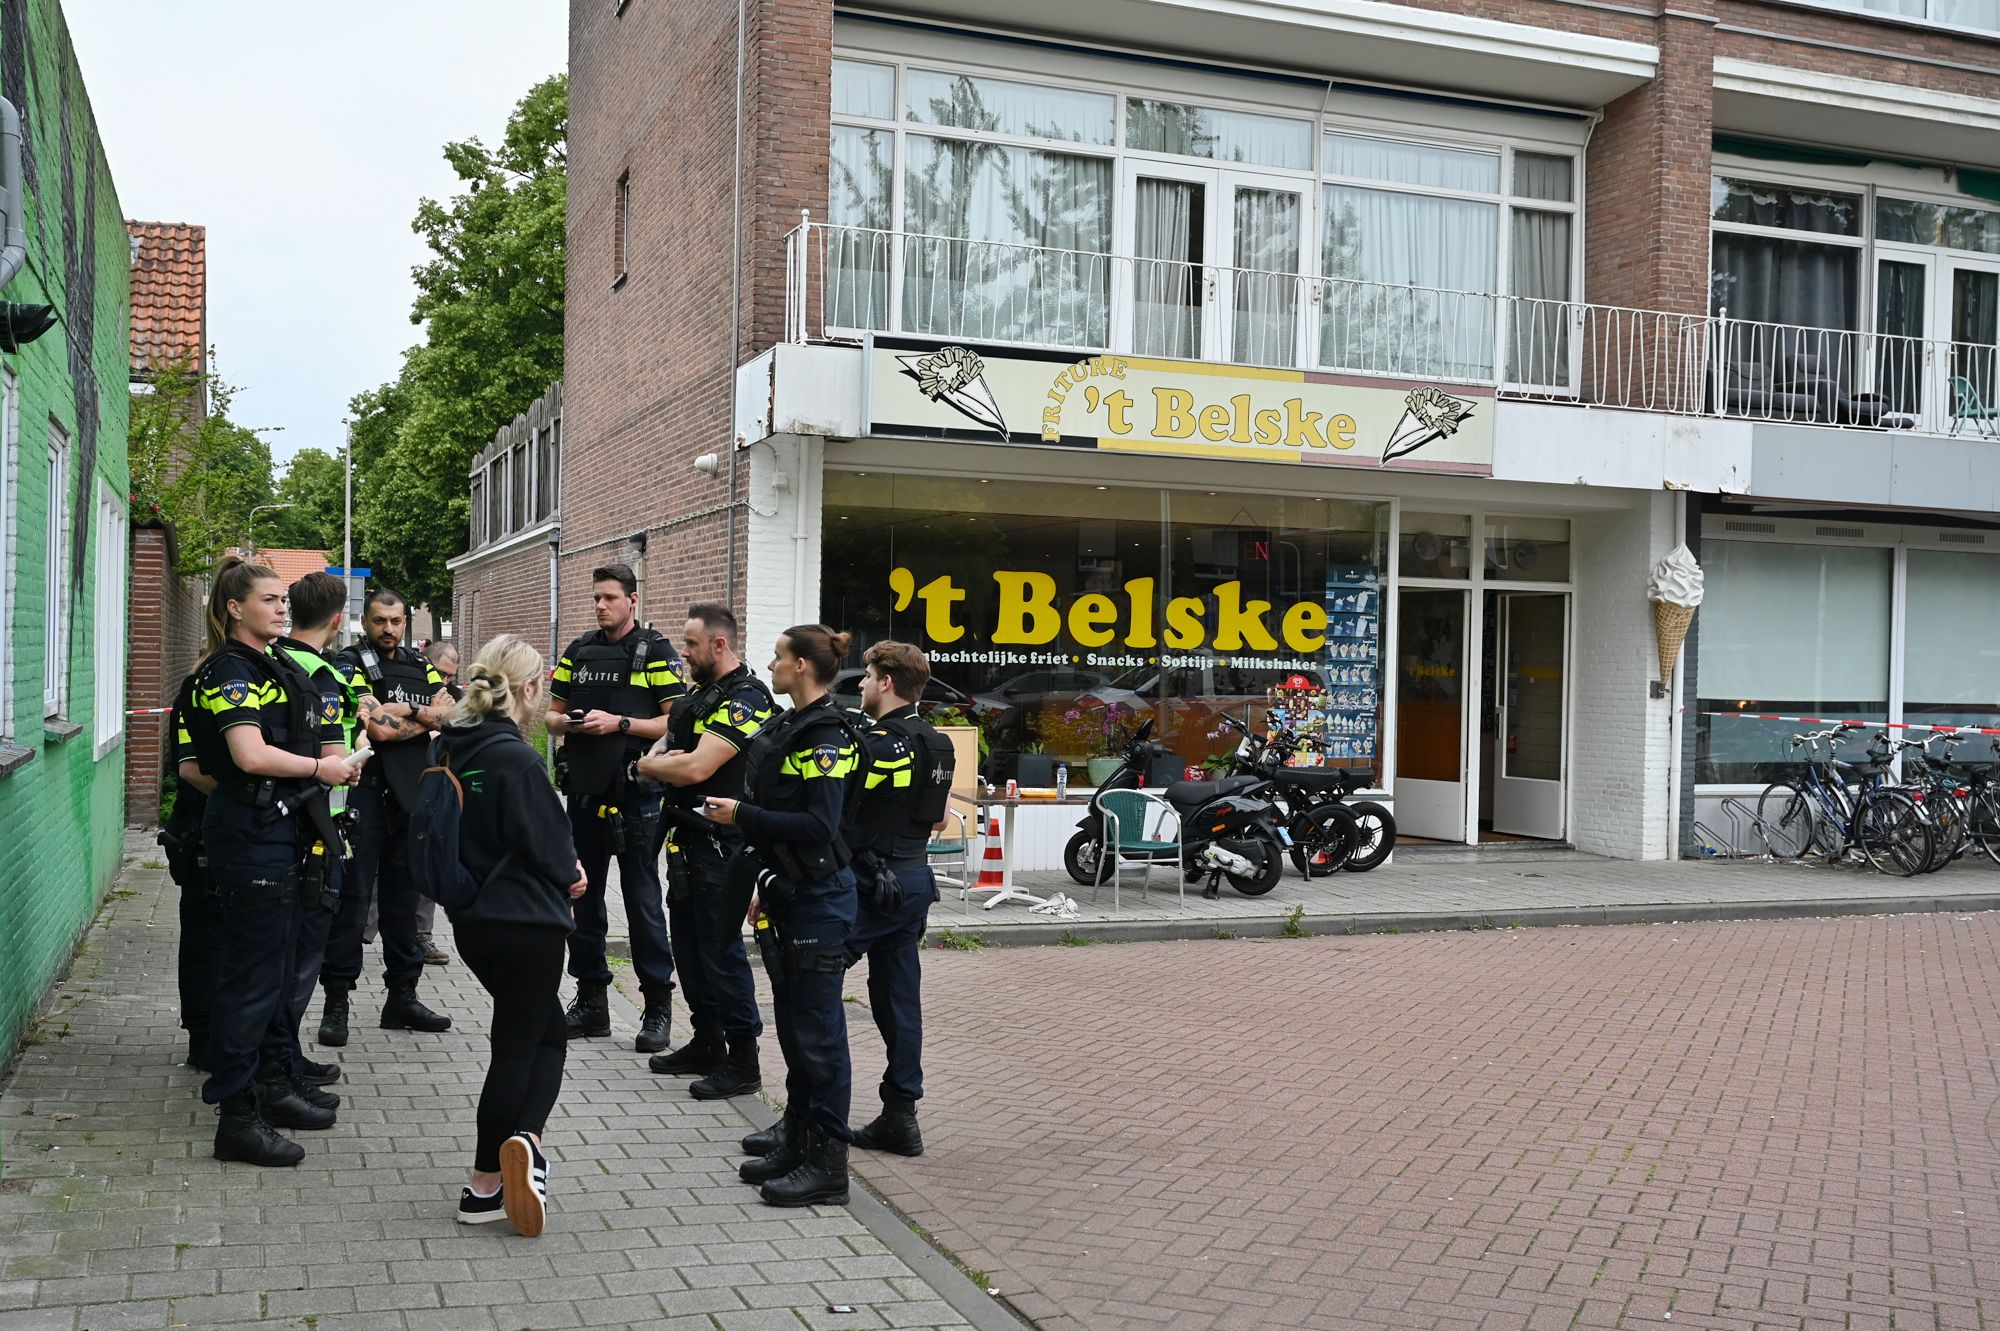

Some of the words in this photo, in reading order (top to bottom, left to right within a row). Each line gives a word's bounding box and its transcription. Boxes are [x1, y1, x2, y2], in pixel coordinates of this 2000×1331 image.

[1042, 357, 1128, 443] FRITURE
[1151, 387, 1357, 450] Belske
[992, 570, 1328, 653] Belske
[573, 665, 619, 684] POLITIE
[1030, 651, 1070, 666] friet
[1086, 653, 1144, 668] Snacks
[1162, 653, 1215, 671] Softijs
[1231, 655, 1318, 672] Milkshakes
[388, 684, 430, 705] POLITIE
